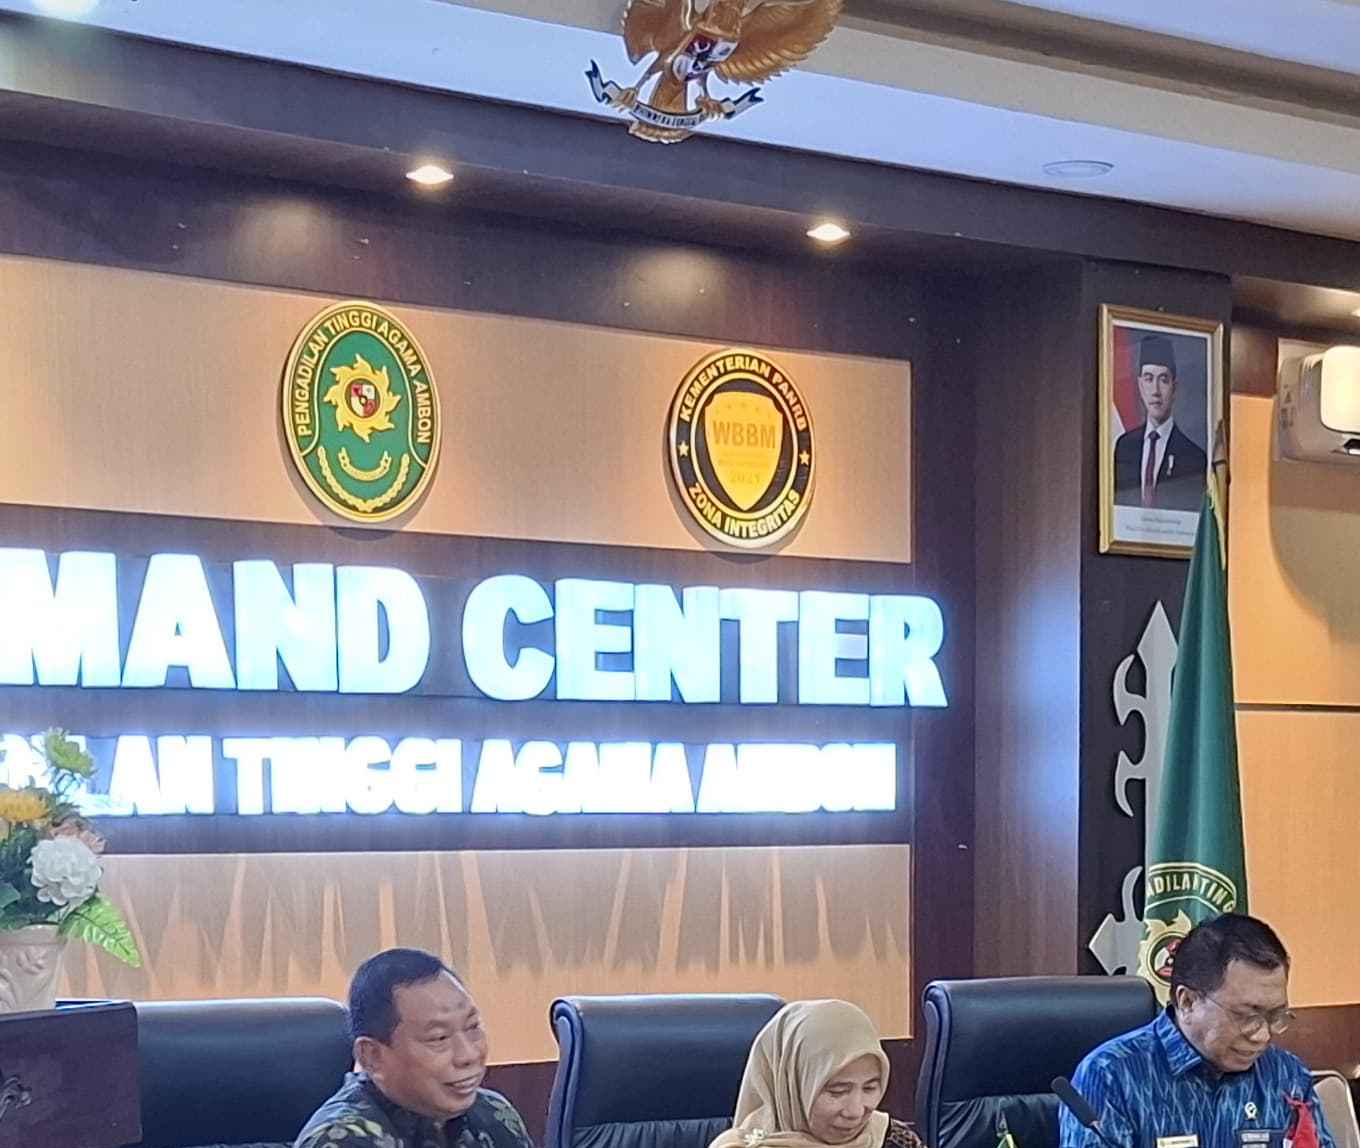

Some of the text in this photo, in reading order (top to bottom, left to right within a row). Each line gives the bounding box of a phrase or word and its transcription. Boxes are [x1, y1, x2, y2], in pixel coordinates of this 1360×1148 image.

[294, 310, 433, 443] PENGADILAN TINGGI AGAMA AMBON
[679, 356, 808, 431] KEMENTERIAN PANRB
[712, 420, 776, 449] WBBM
[688, 482, 801, 539] ZONA INTEGRITAS
[460, 573, 949, 708] CENTER
